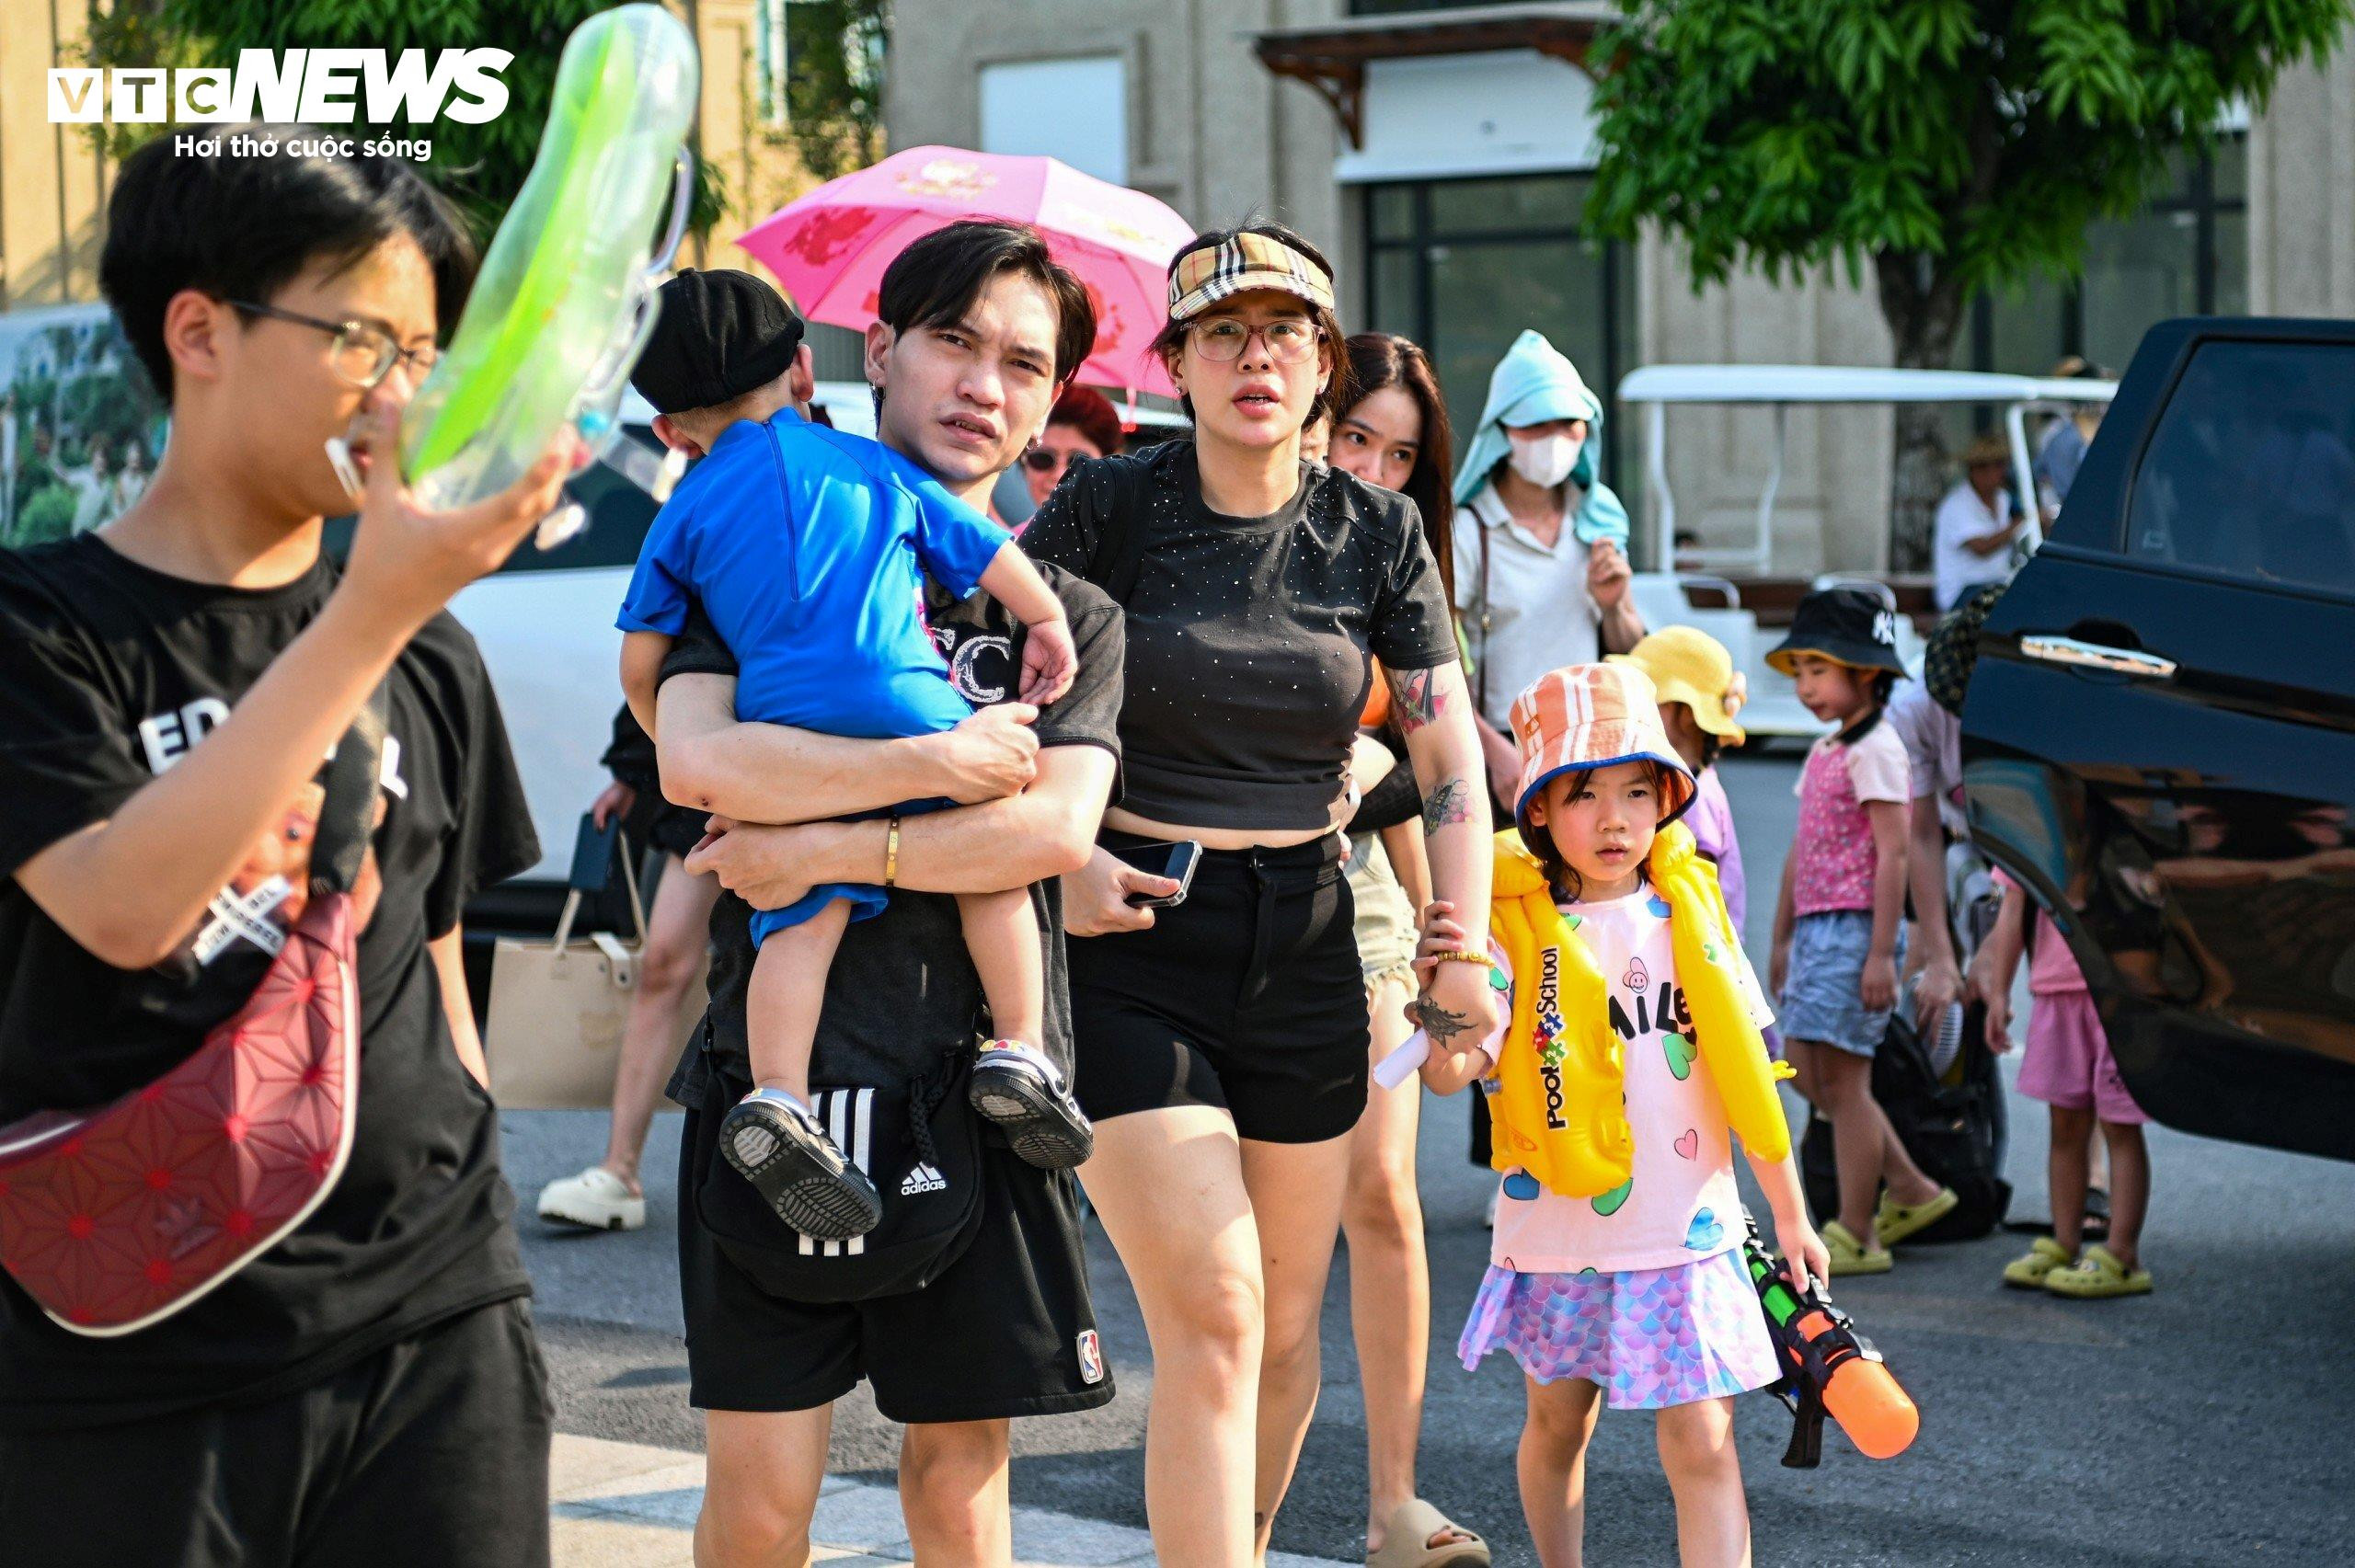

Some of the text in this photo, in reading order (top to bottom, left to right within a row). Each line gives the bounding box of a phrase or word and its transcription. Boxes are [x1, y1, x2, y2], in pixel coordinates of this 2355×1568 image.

[1536, 947, 1567, 1129] Pool School
[902, 1180, 947, 1196] adidas
